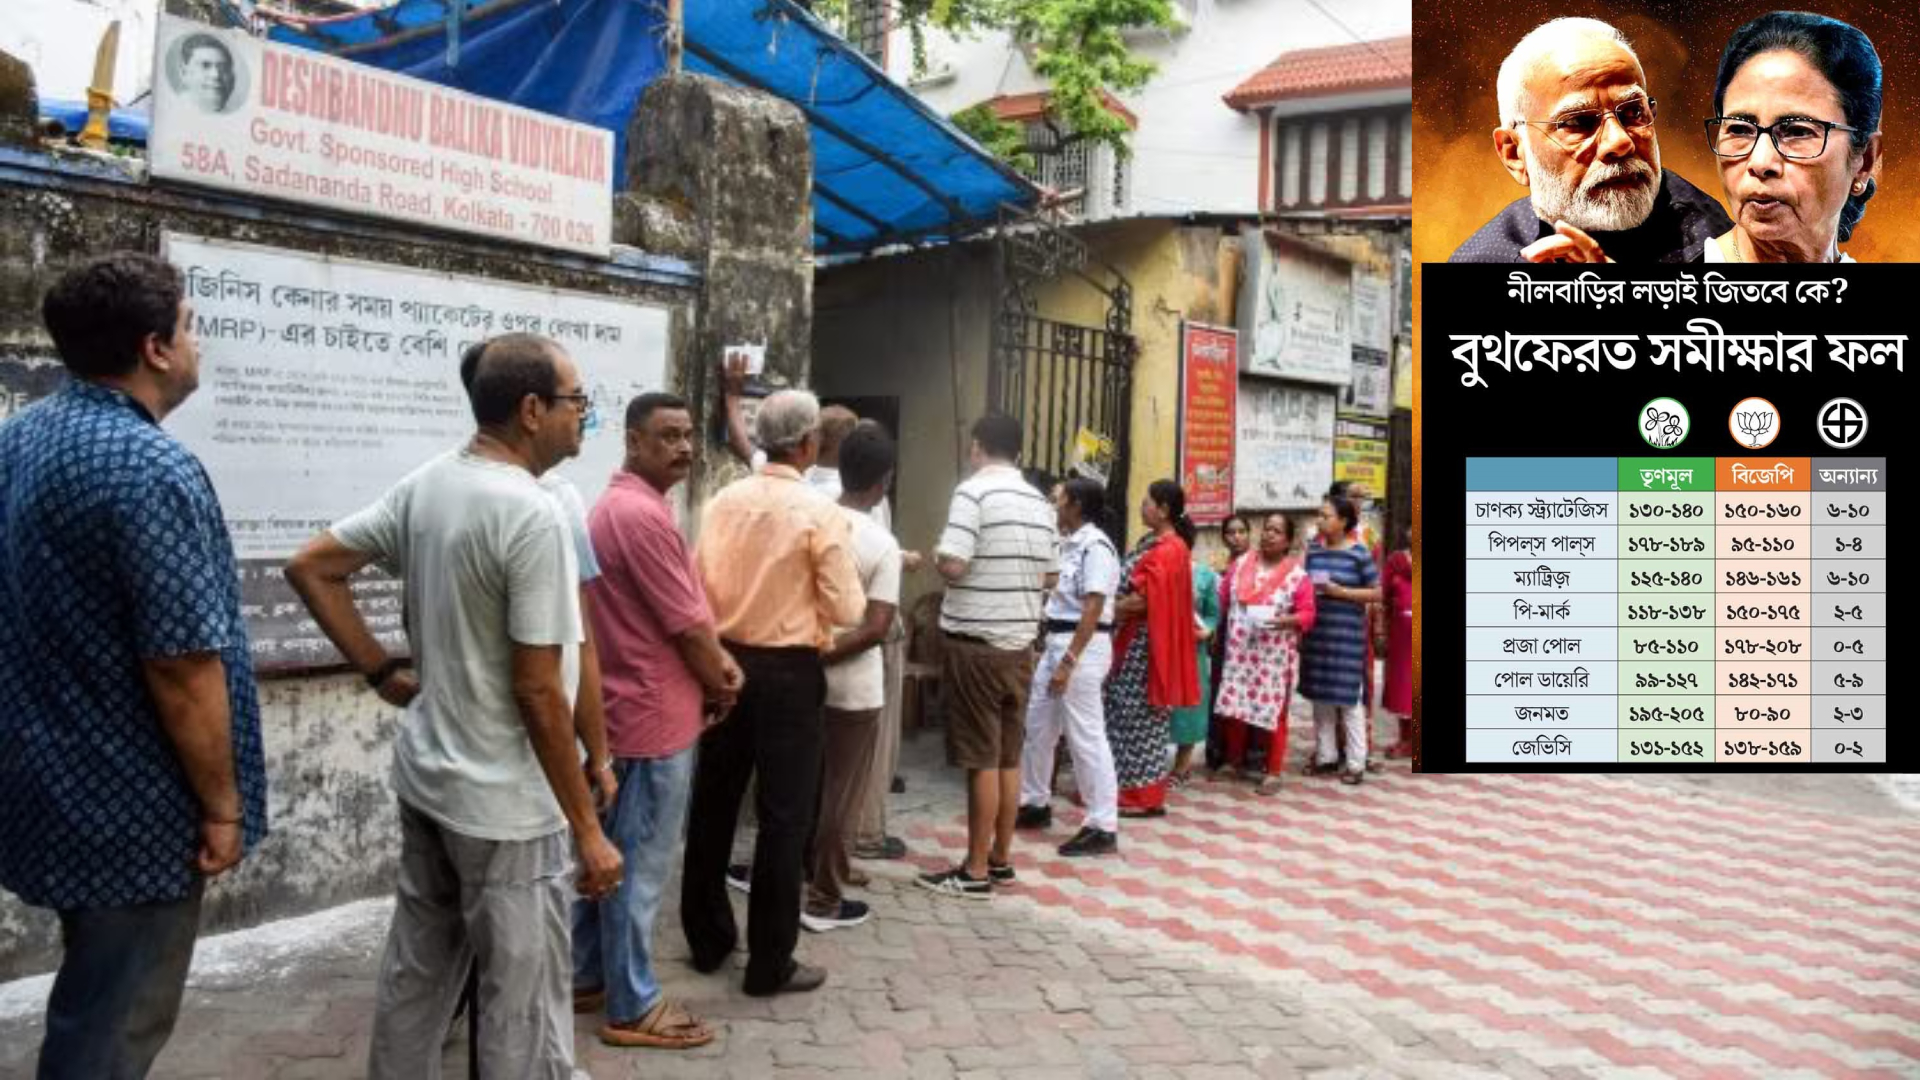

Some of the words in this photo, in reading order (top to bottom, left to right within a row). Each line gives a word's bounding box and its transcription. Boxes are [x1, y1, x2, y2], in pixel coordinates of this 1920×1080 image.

[251, 116, 311, 153] Govt.
[320, 132, 434, 179] Sponsored
[441, 161, 484, 193] High
[490, 171, 553, 202] School
[262, 51, 423, 142] DESHBANDHU
[429, 91, 503, 160] BALIKA
[509, 112, 605, 184] VIDYALAYA
[180, 142, 235, 184] 58A,
[245, 156, 371, 203] Sadananda
[379, 183, 437, 219] Road,
[443, 197, 515, 230] Kolkata
[530, 212, 561, 239] 700
[565, 219, 595, 244] 026
[187, 265, 261, 305] জিনিস
[271, 285, 339, 313] কেনার
[346, 292, 393, 320] সময়
[400, 300, 494, 330] প্যাকেটের
[197, 315, 316, 346] MRP)-এর
[323, 323, 393, 353] চাইতে
[400, 329, 448, 358] বেশি
